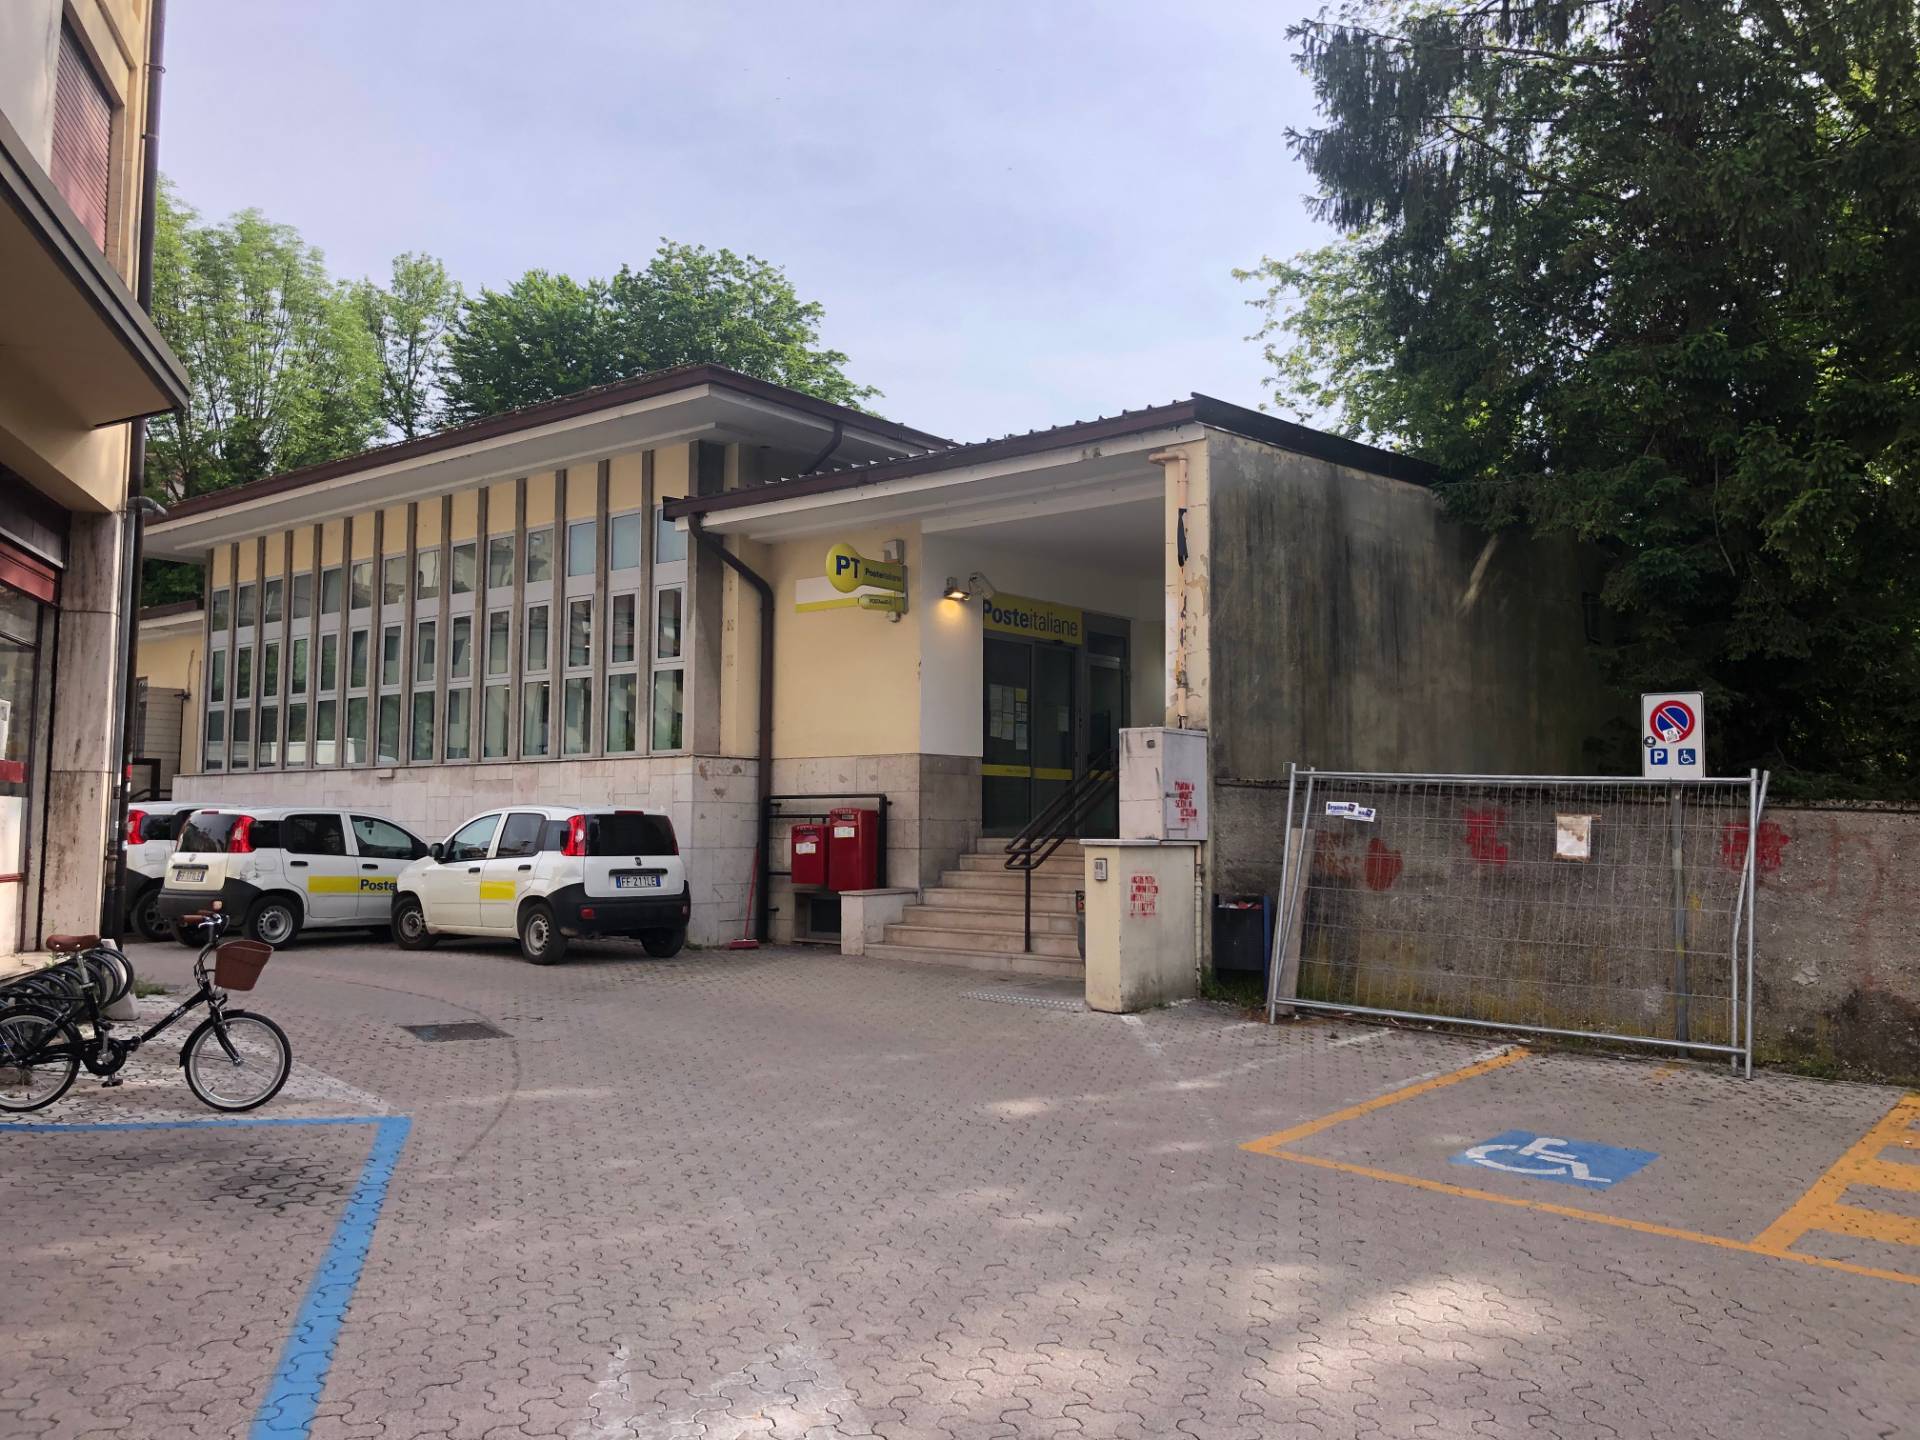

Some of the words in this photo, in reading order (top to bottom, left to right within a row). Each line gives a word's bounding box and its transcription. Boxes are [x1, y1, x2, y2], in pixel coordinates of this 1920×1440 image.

[835, 555, 861, 579] PT
[983, 599, 1078, 637] Posteitaliane
[1654, 751, 1664, 763] P
[360, 878, 397, 891] Poste
[621, 877, 631, 887] FF
[633, 876, 656, 887] 211LE
